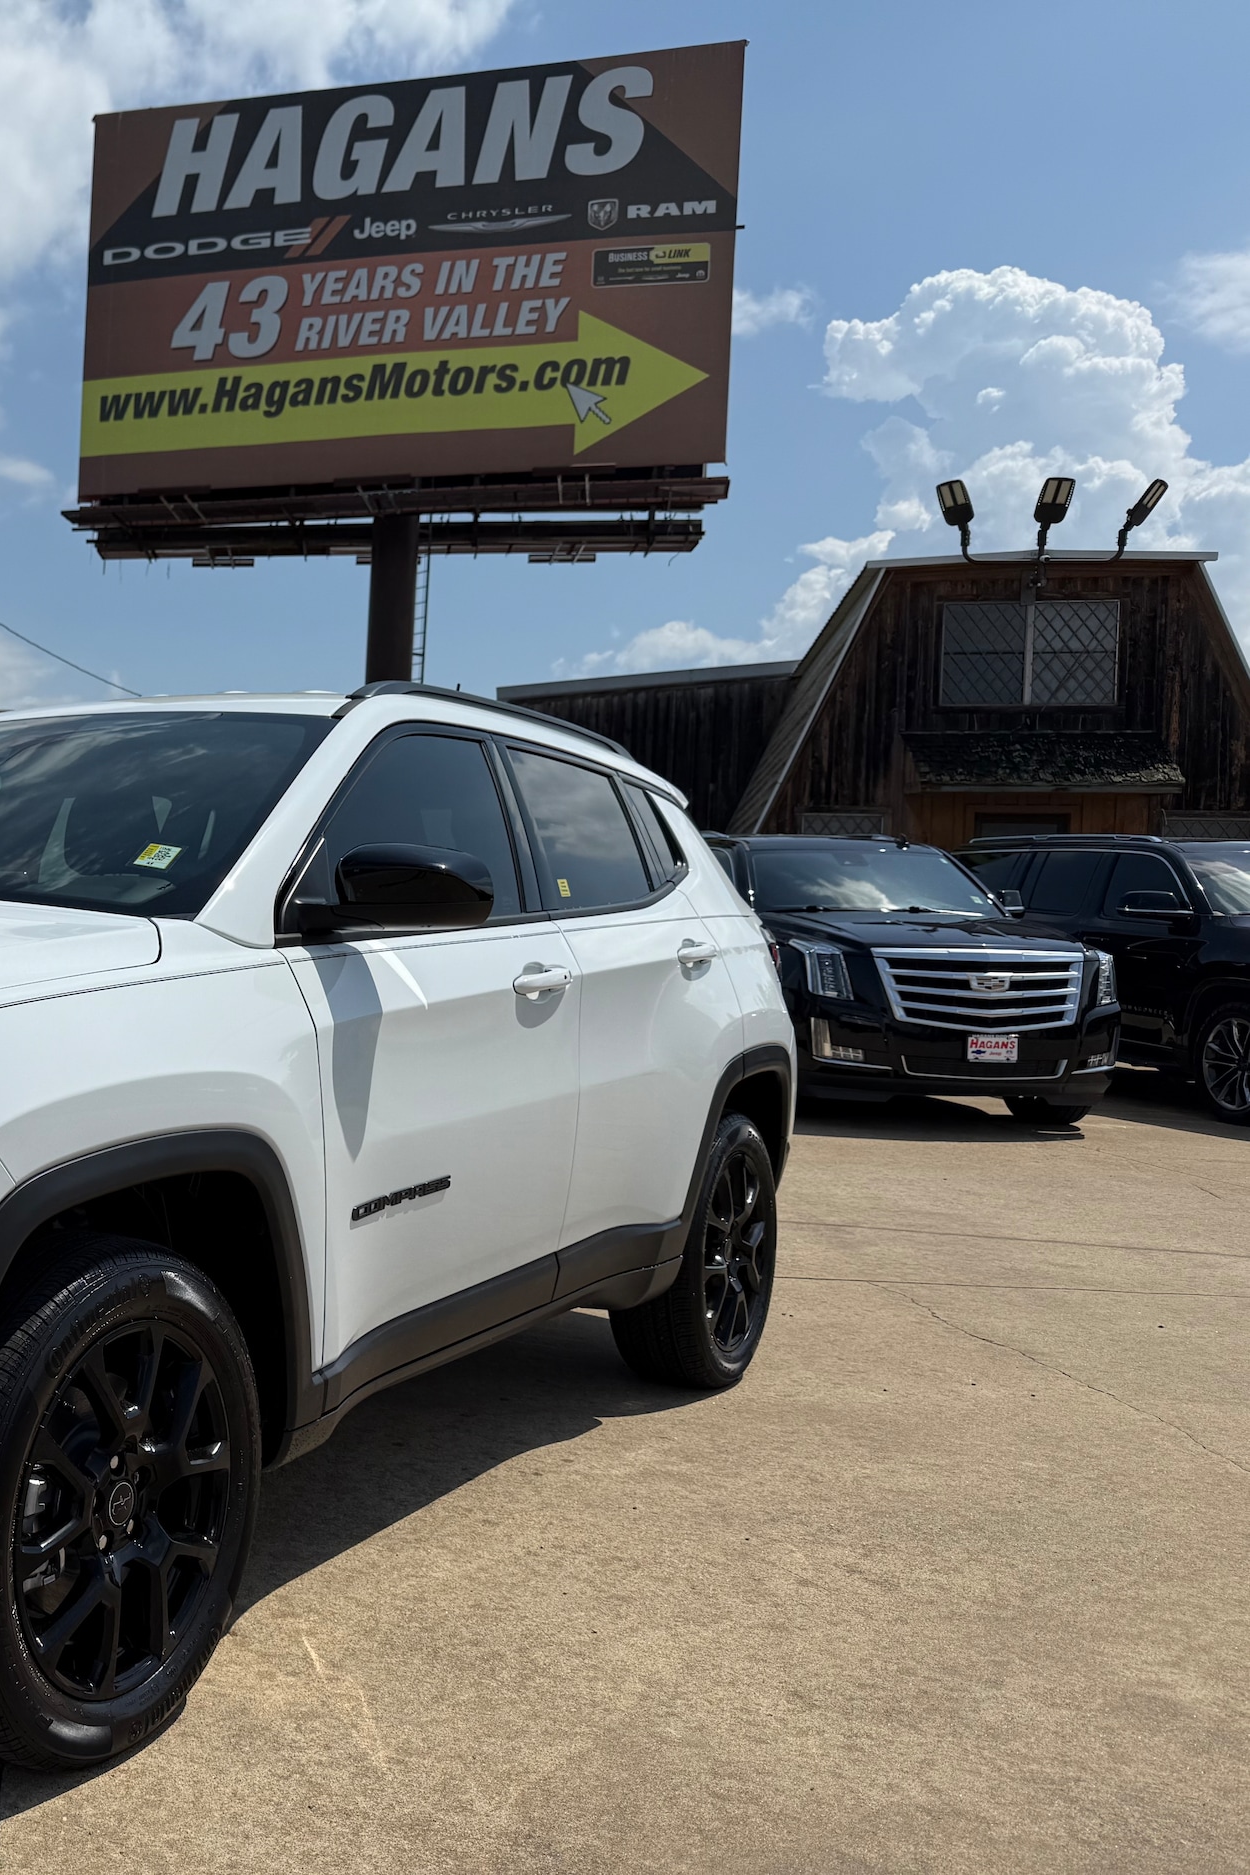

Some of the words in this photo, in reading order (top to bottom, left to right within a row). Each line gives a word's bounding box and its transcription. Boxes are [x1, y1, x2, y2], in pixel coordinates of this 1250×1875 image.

[151, 66, 654, 218] HAGANS
[353, 216, 417, 240] Jeep
[447, 204, 553, 220] CHRYSLER
[627, 200, 717, 219] RAM
[103, 227, 311, 266] DODGE
[608, 251, 648, 263] BUSINESS
[667, 248, 692, 260] LINK
[302, 263, 424, 307] YEARS
[434, 258, 480, 296] IN
[492, 252, 567, 291] THE
[170, 275, 289, 361] 43
[294, 309, 410, 352] RIVER
[423, 297, 571, 341] VALLEY
[99, 355, 631, 422] www.HagansMotors.com
[969, 1038, 1016, 1050] HAGANS
[351, 1175, 451, 1221] COMPASS
